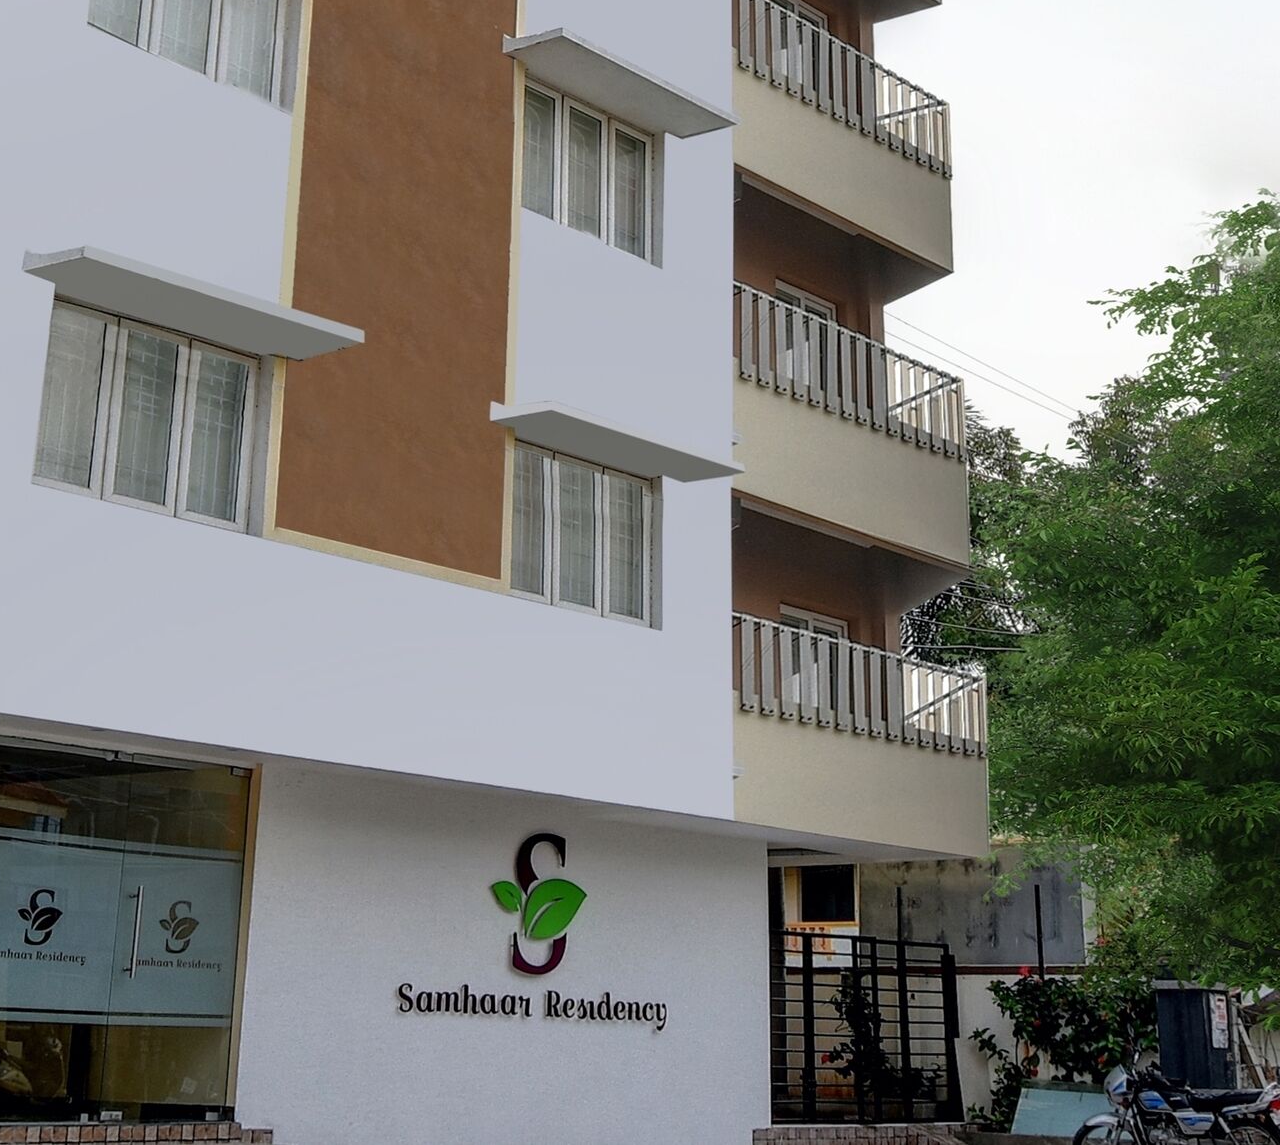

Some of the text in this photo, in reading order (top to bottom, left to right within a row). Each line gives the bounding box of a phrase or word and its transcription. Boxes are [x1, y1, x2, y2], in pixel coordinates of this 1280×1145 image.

[36, 951, 86, 966] Residency
[135, 957, 221, 972] amhaar Residency
[397, 983, 667, 1032] Samhaar Residency
